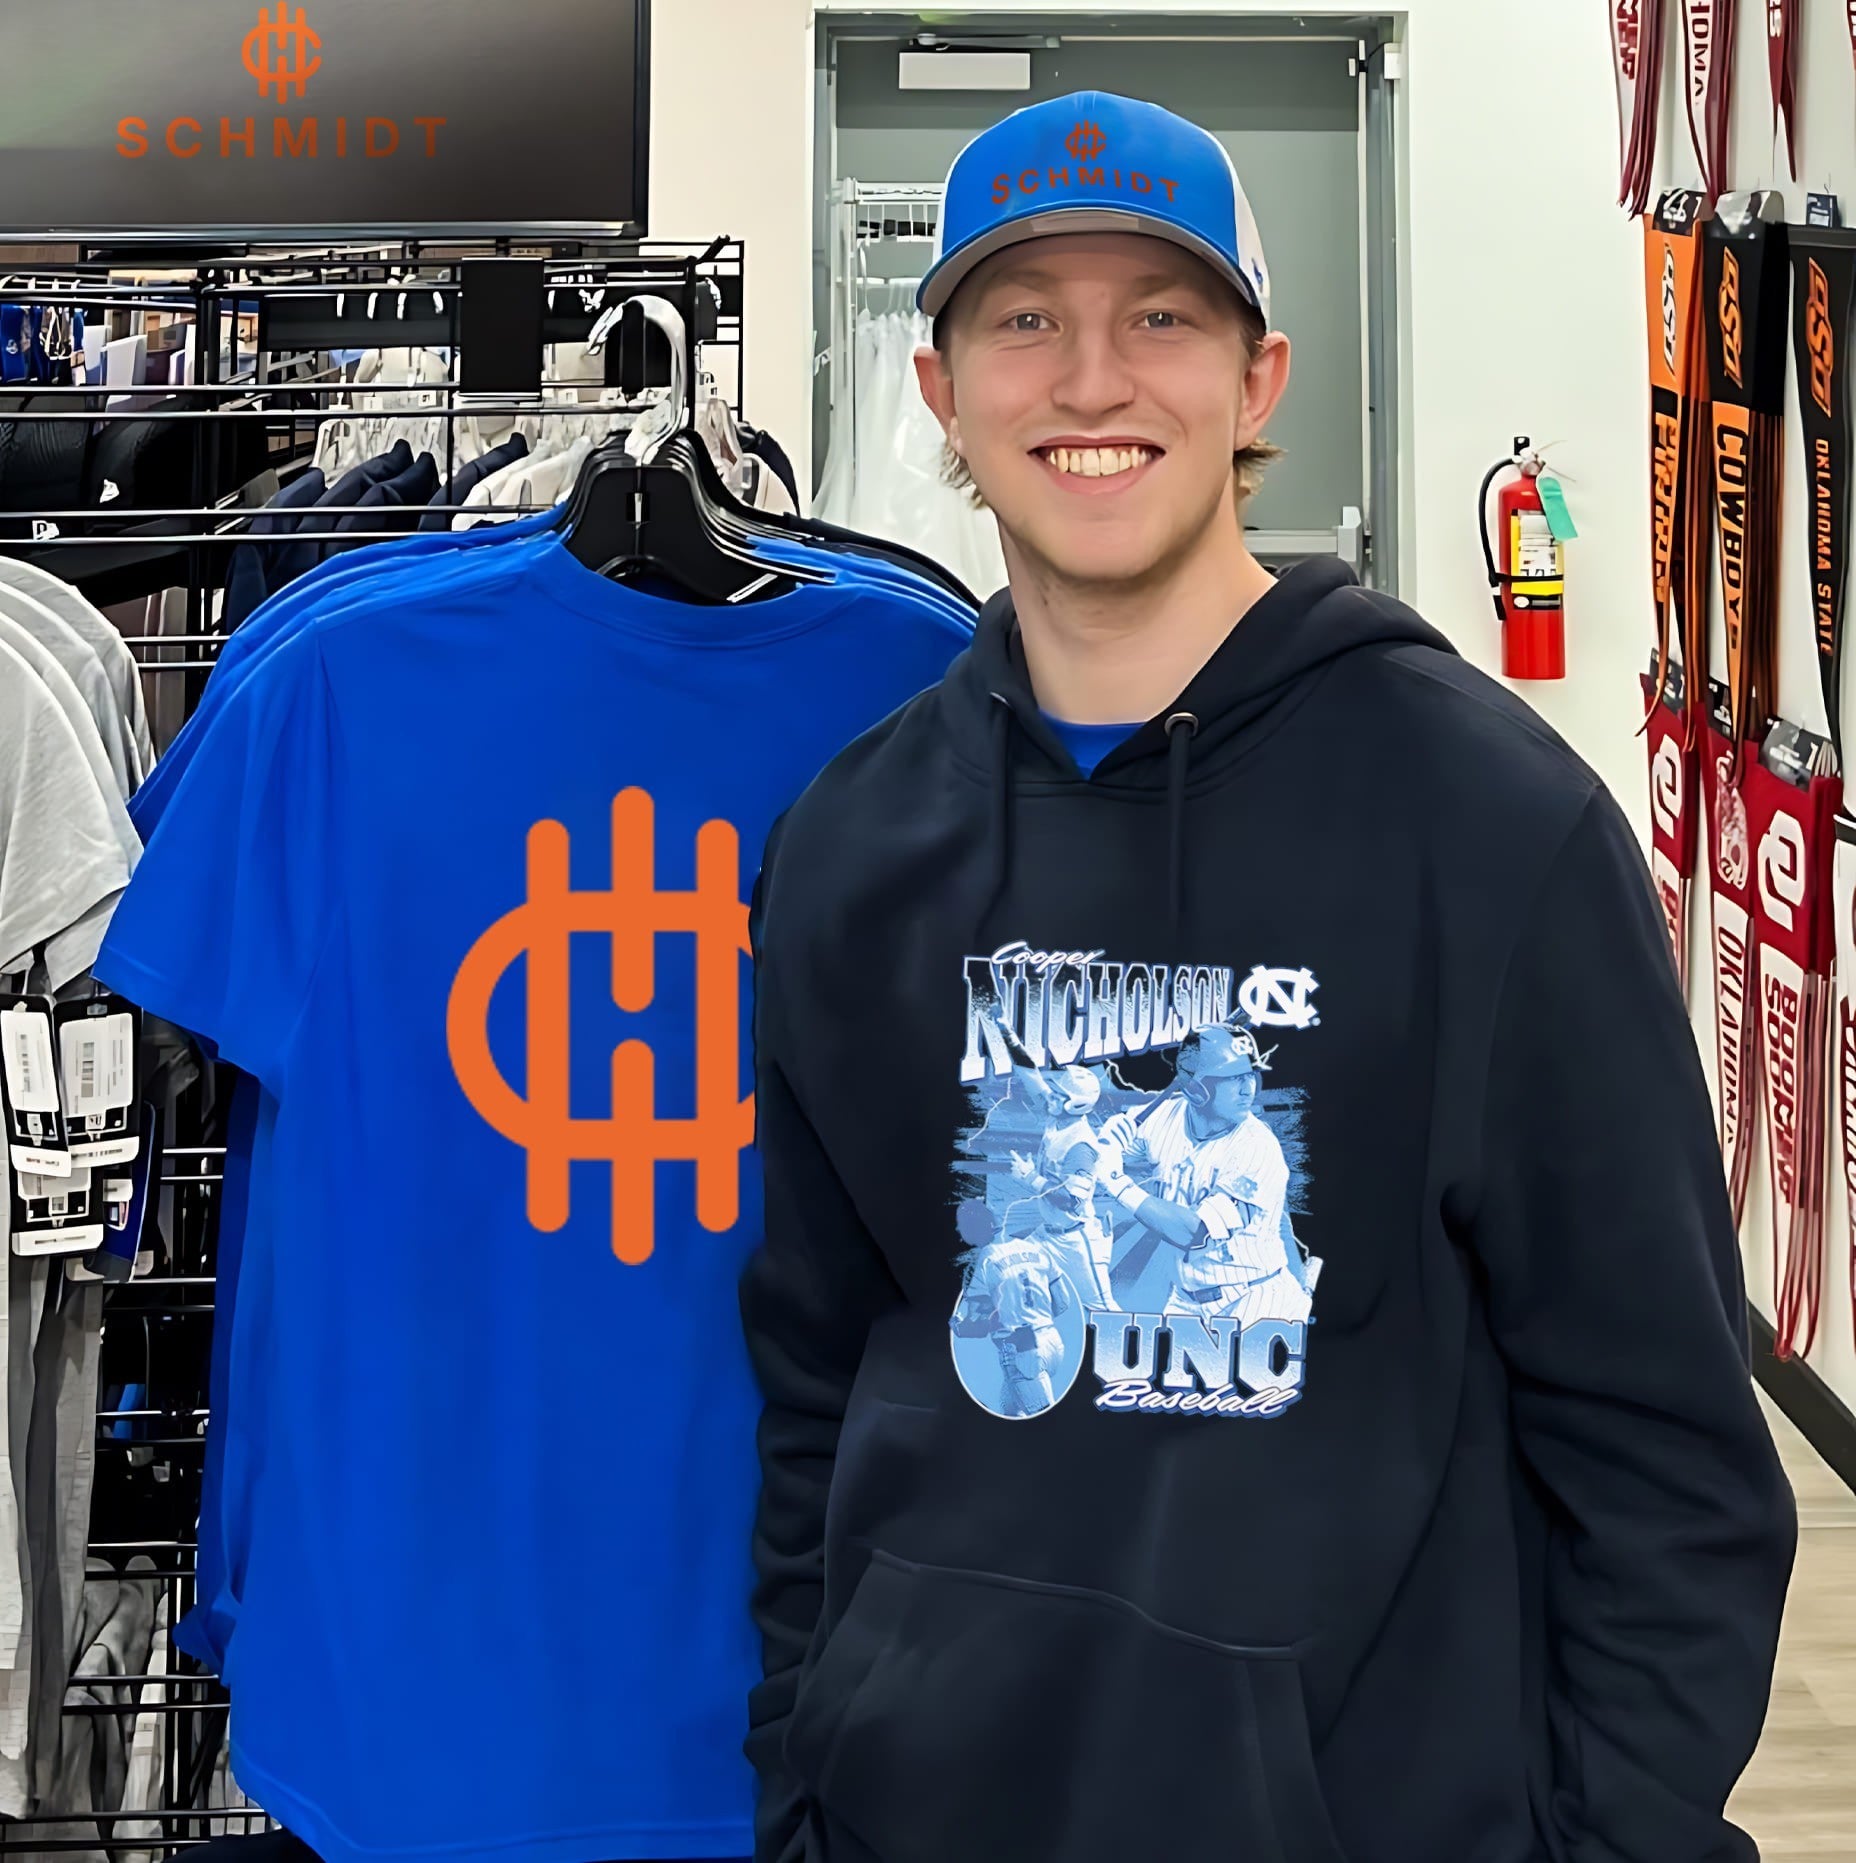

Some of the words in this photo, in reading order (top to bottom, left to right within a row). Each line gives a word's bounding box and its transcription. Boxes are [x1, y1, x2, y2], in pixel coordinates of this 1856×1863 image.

[115, 117, 447, 159] SCHMIDT
[991, 167, 1179, 205] SCHMIDT
[1815, 438, 1832, 570] OKLAHOMA
[991, 941, 1105, 973] Cooper
[960, 956, 1234, 1084] NICHOLSON
[1718, 926, 1745, 1144] OKLAHOMA
[1087, 1310, 1306, 1392] UNC
[1096, 1378, 1299, 1415] Baseball
